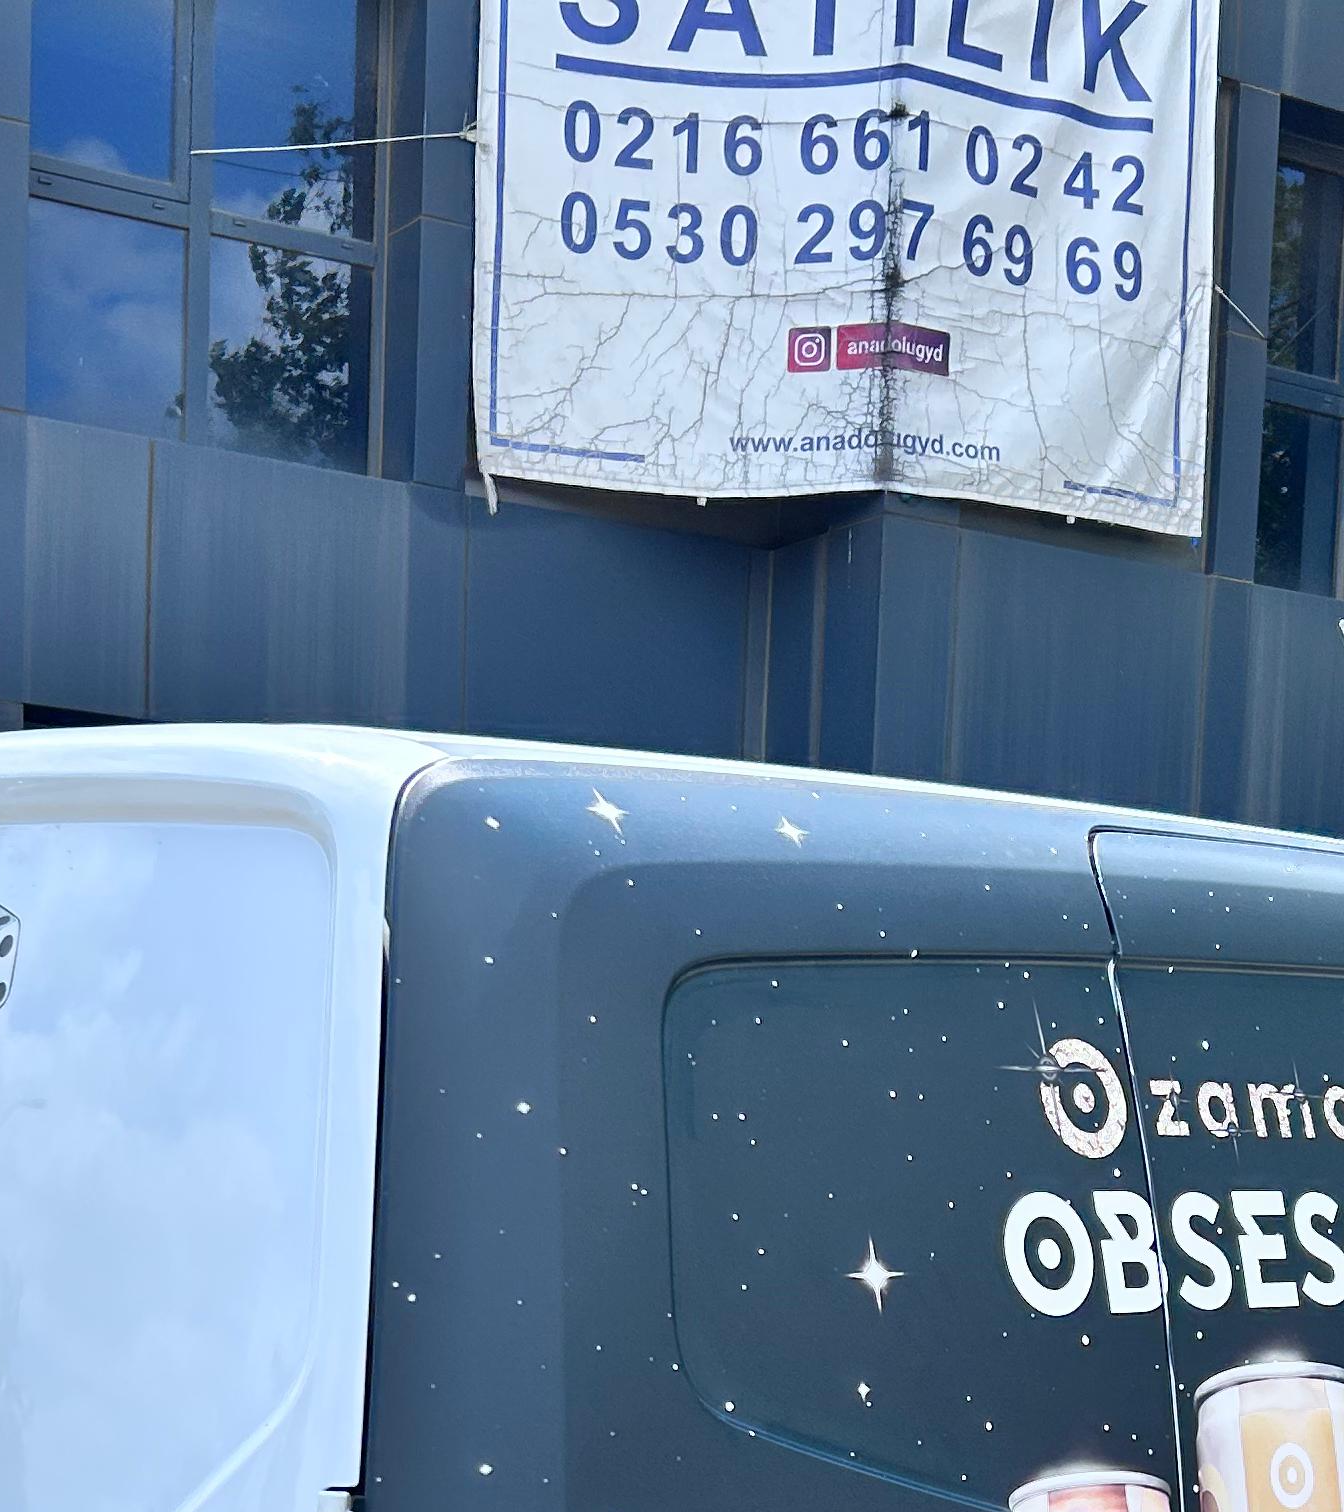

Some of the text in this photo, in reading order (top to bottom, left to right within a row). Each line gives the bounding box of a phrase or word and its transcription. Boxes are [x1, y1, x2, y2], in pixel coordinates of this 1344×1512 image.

[563, 100, 763, 176] 0216
[800, 108, 931, 176] 661
[560, 191, 1143, 301] 0530 297 69 69
[729, 428, 1001, 461] www.anadougyd.com
